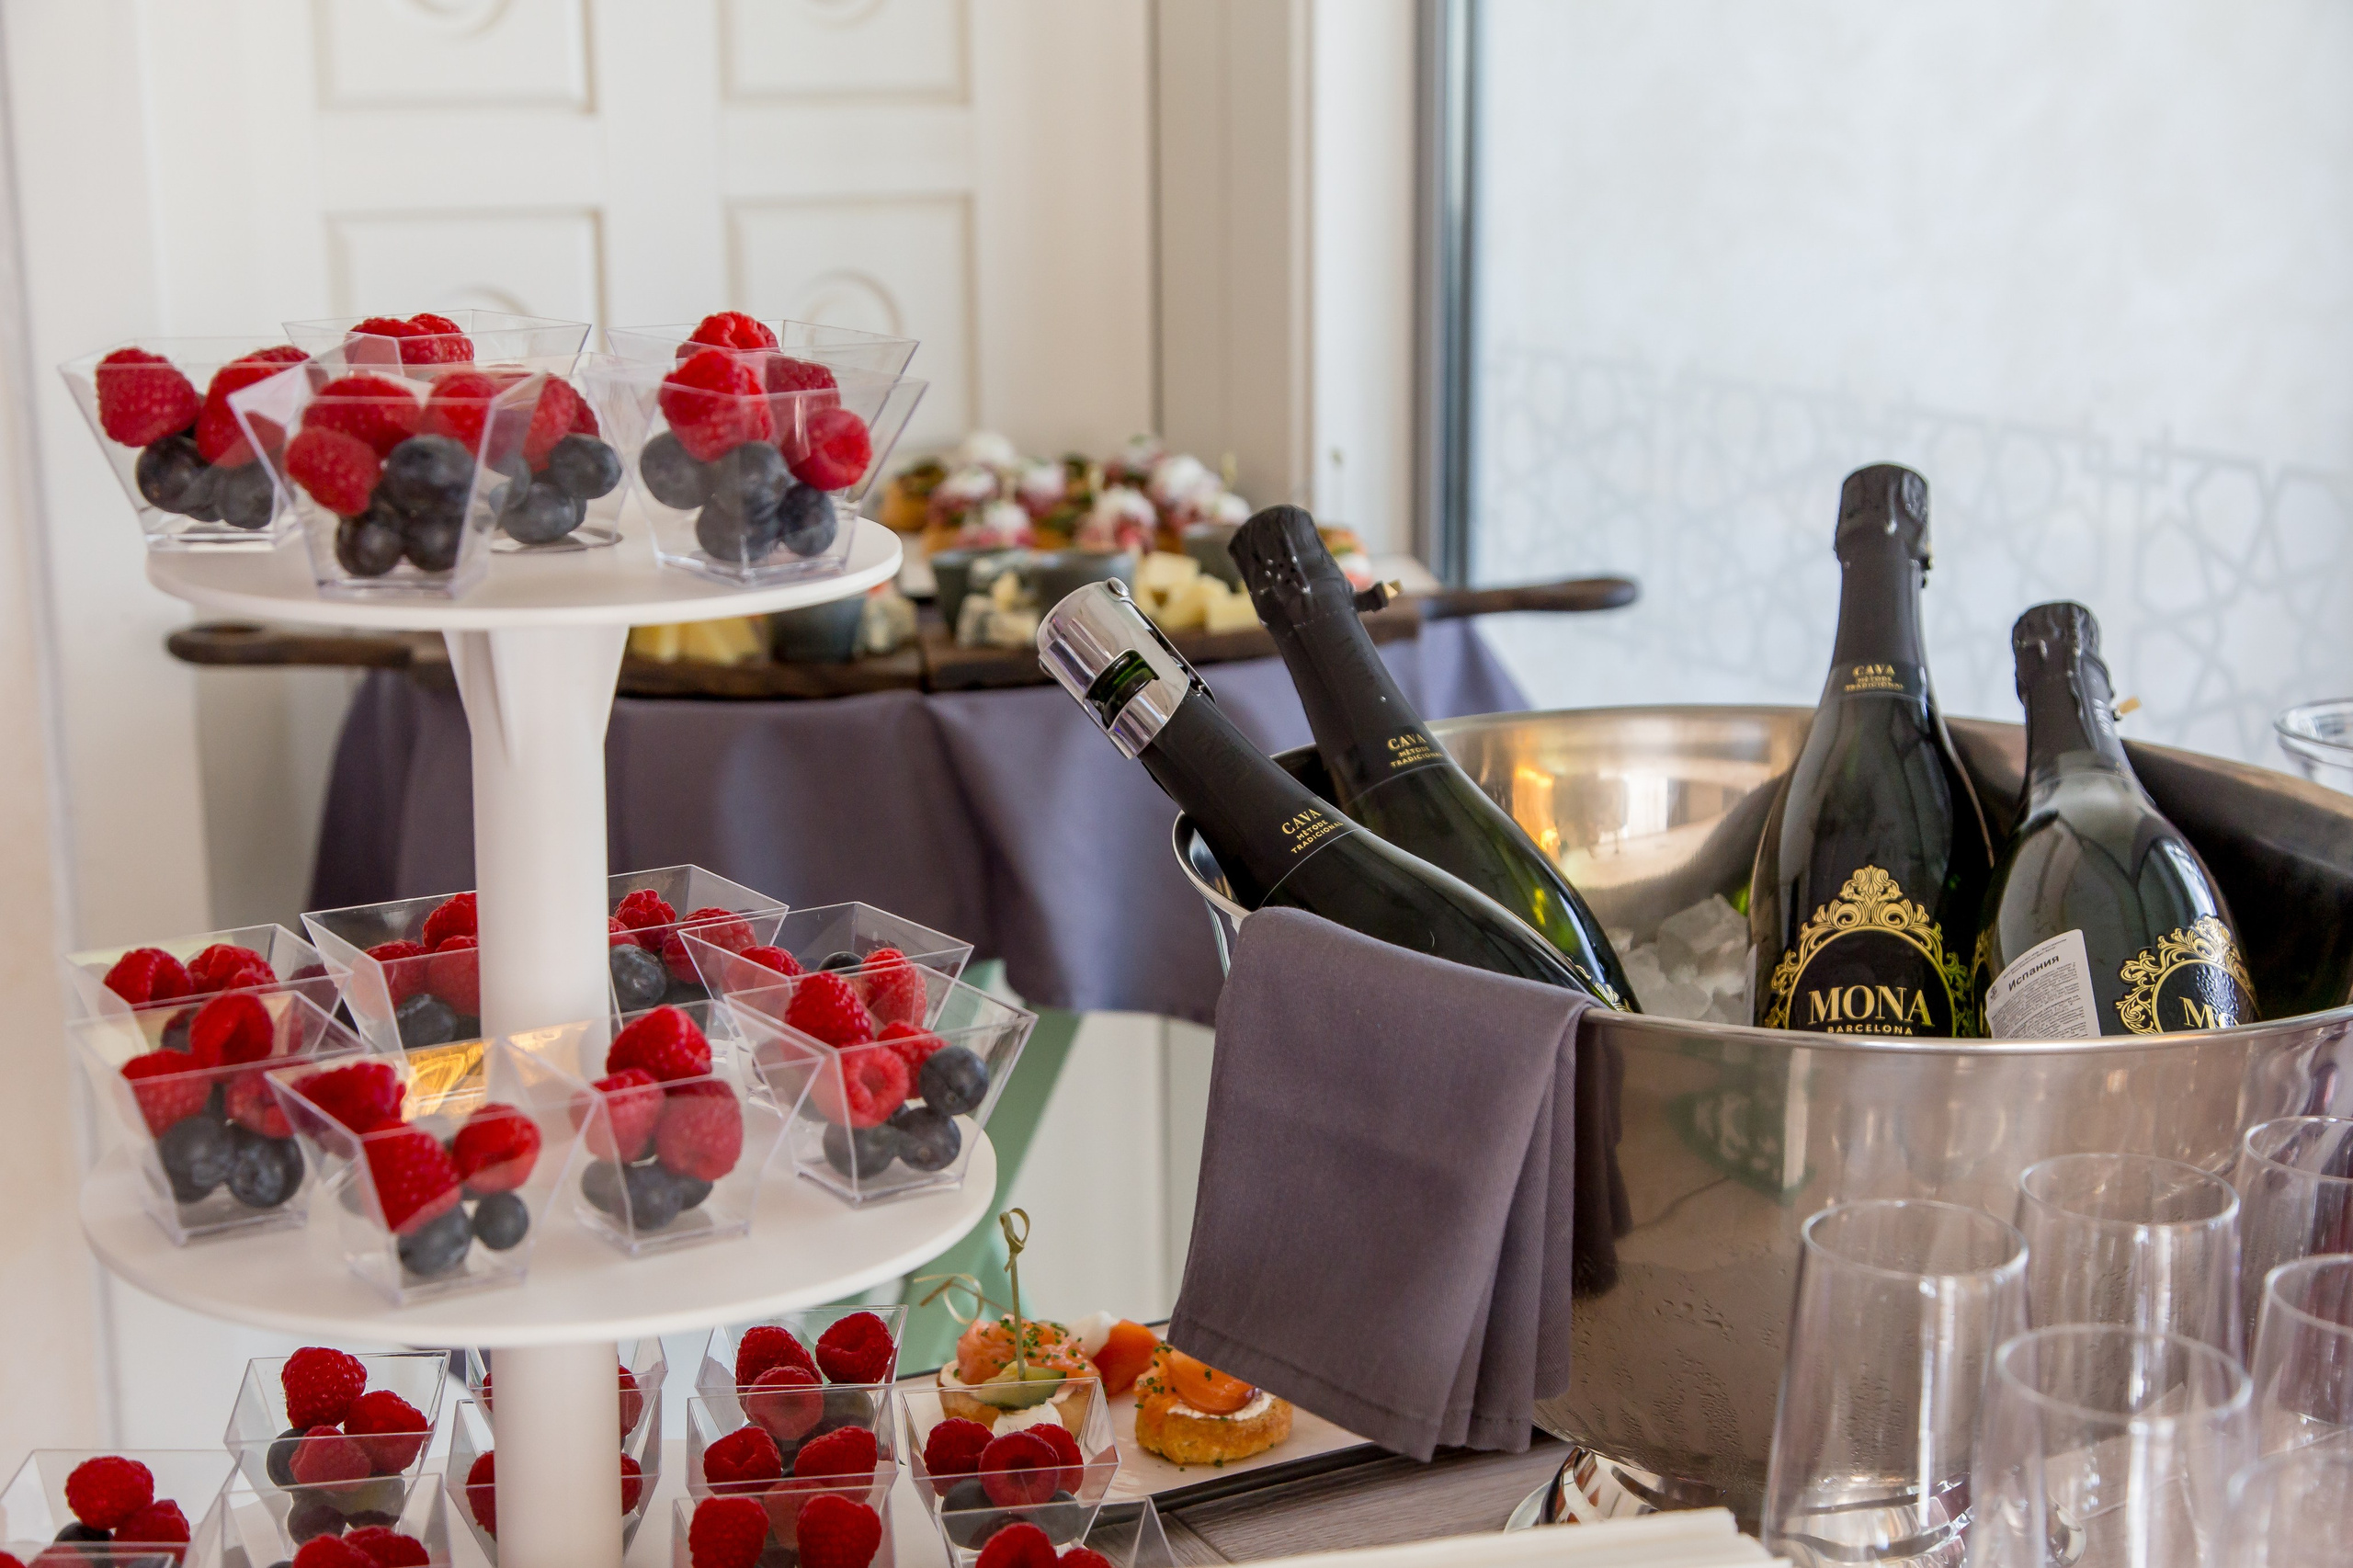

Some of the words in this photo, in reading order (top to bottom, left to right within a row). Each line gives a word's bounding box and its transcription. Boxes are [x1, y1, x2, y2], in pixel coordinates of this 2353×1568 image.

[1852, 664, 1895, 677] CAVA
[1388, 733, 1427, 751] CAVA
[1390, 752, 1443, 768] TRADICIONAL
[1281, 809, 1323, 835] CAVA
[1290, 821, 1344, 854] TRADICIONAL
[2008, 955, 2060, 992] Испания
[1807, 984, 1935, 1028] MONA
[1827, 1024, 1913, 1036] BARCELONA
